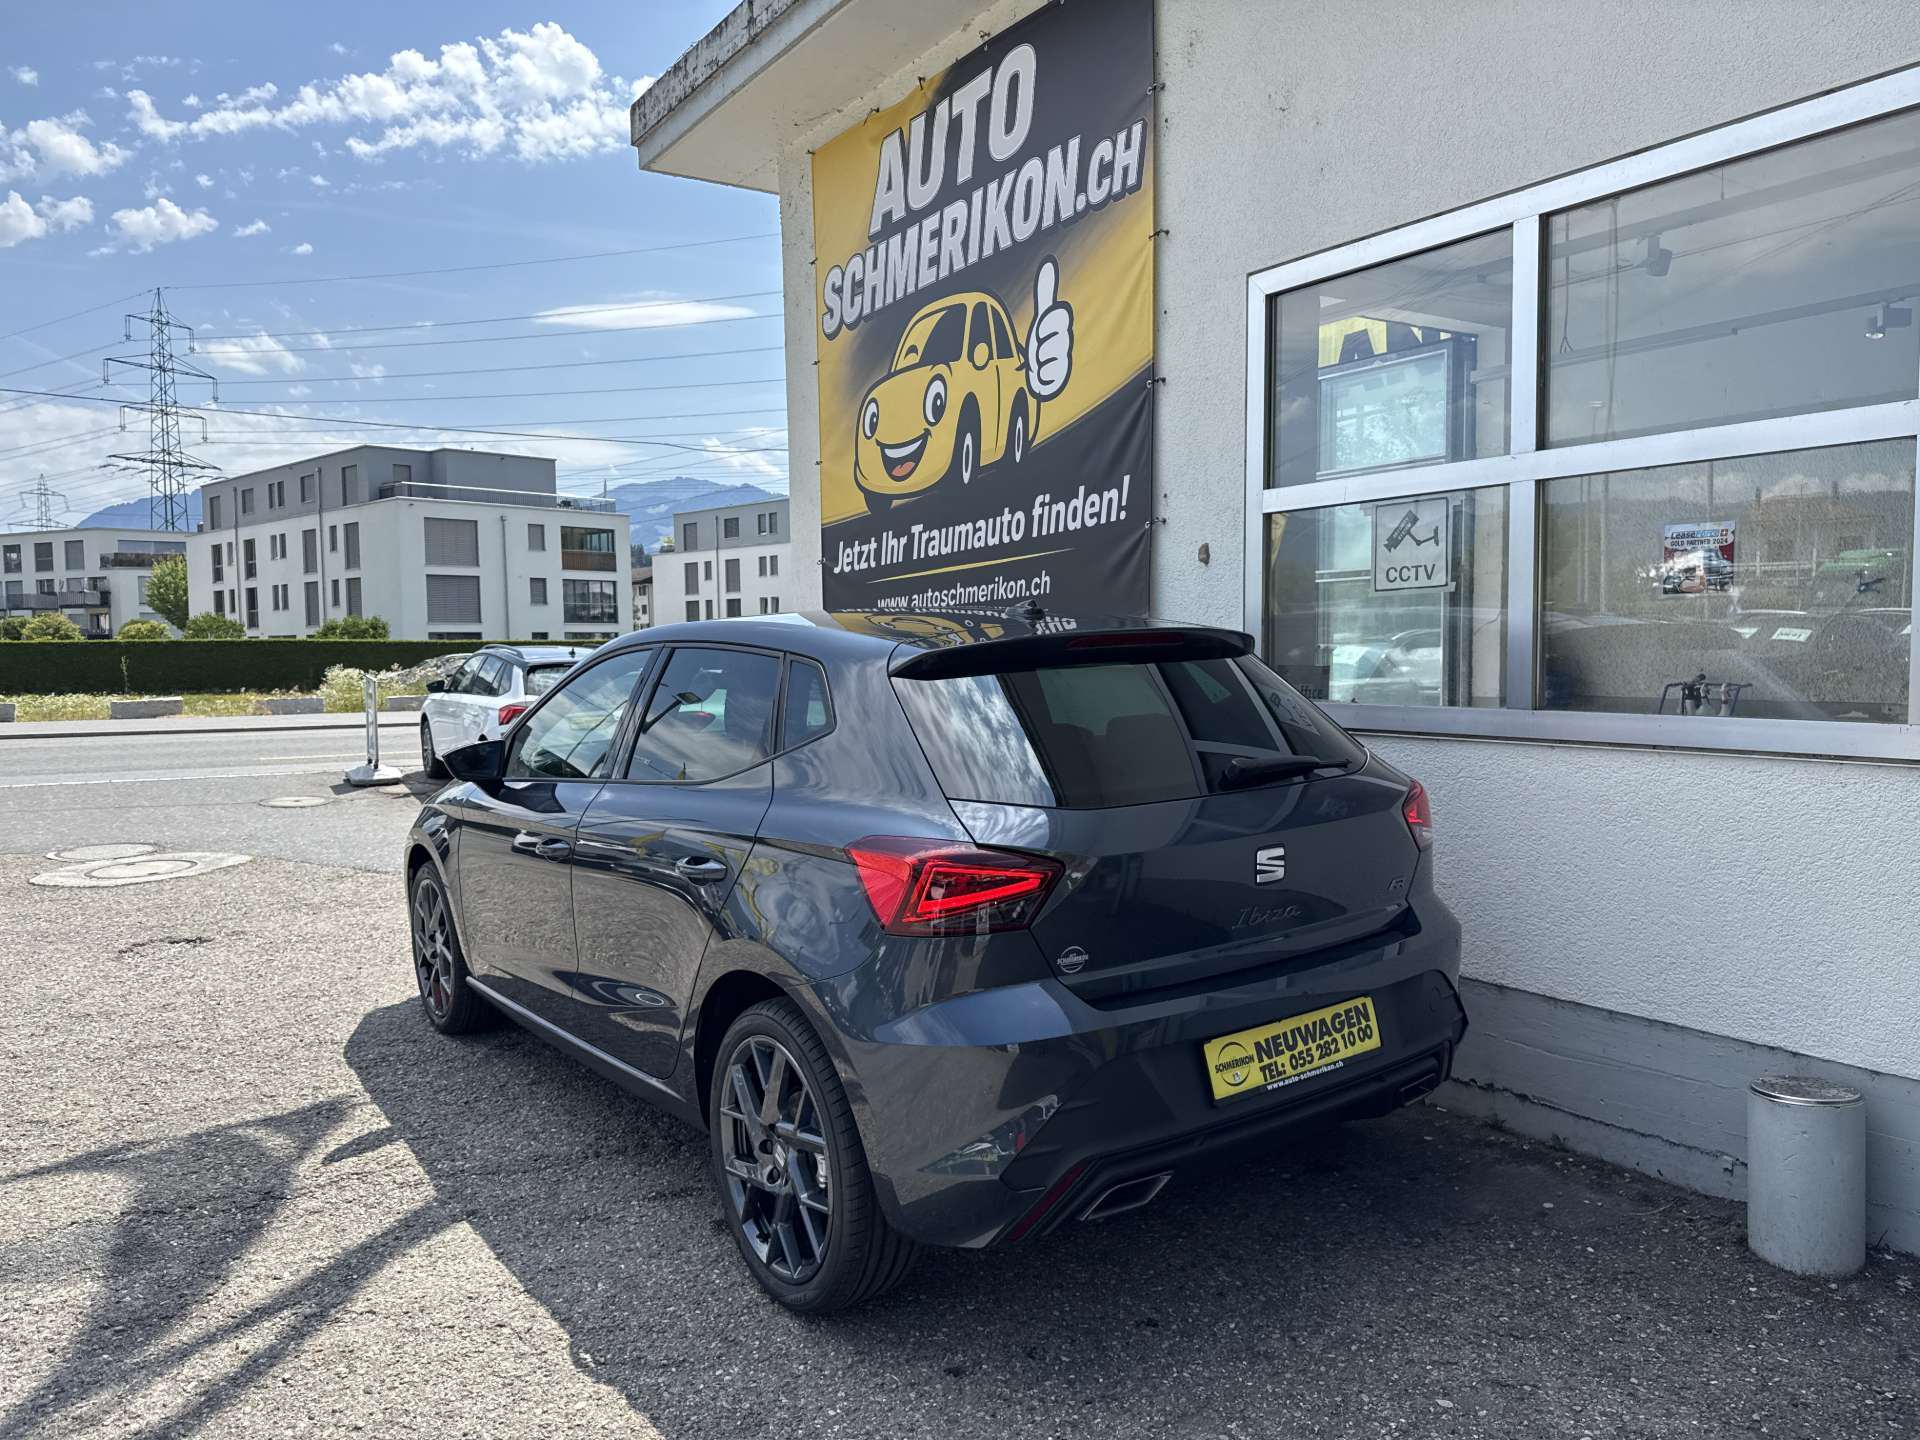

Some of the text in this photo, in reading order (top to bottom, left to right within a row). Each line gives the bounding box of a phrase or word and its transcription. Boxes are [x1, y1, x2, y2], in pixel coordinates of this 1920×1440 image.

[869, 43, 1036, 237] AUTO
[822, 121, 1143, 335] SCHMERIKON.CH
[833, 475, 1130, 573] Jetzt Ihr Traumauto finden!
[1385, 563, 1436, 583] CCTV
[1254, 1002, 1370, 1063] NEUWAGEN
[1259, 1023, 1373, 1082] TEL: 055 282 10 00
[1215, 1053, 1255, 1074] SCHMERIKON
